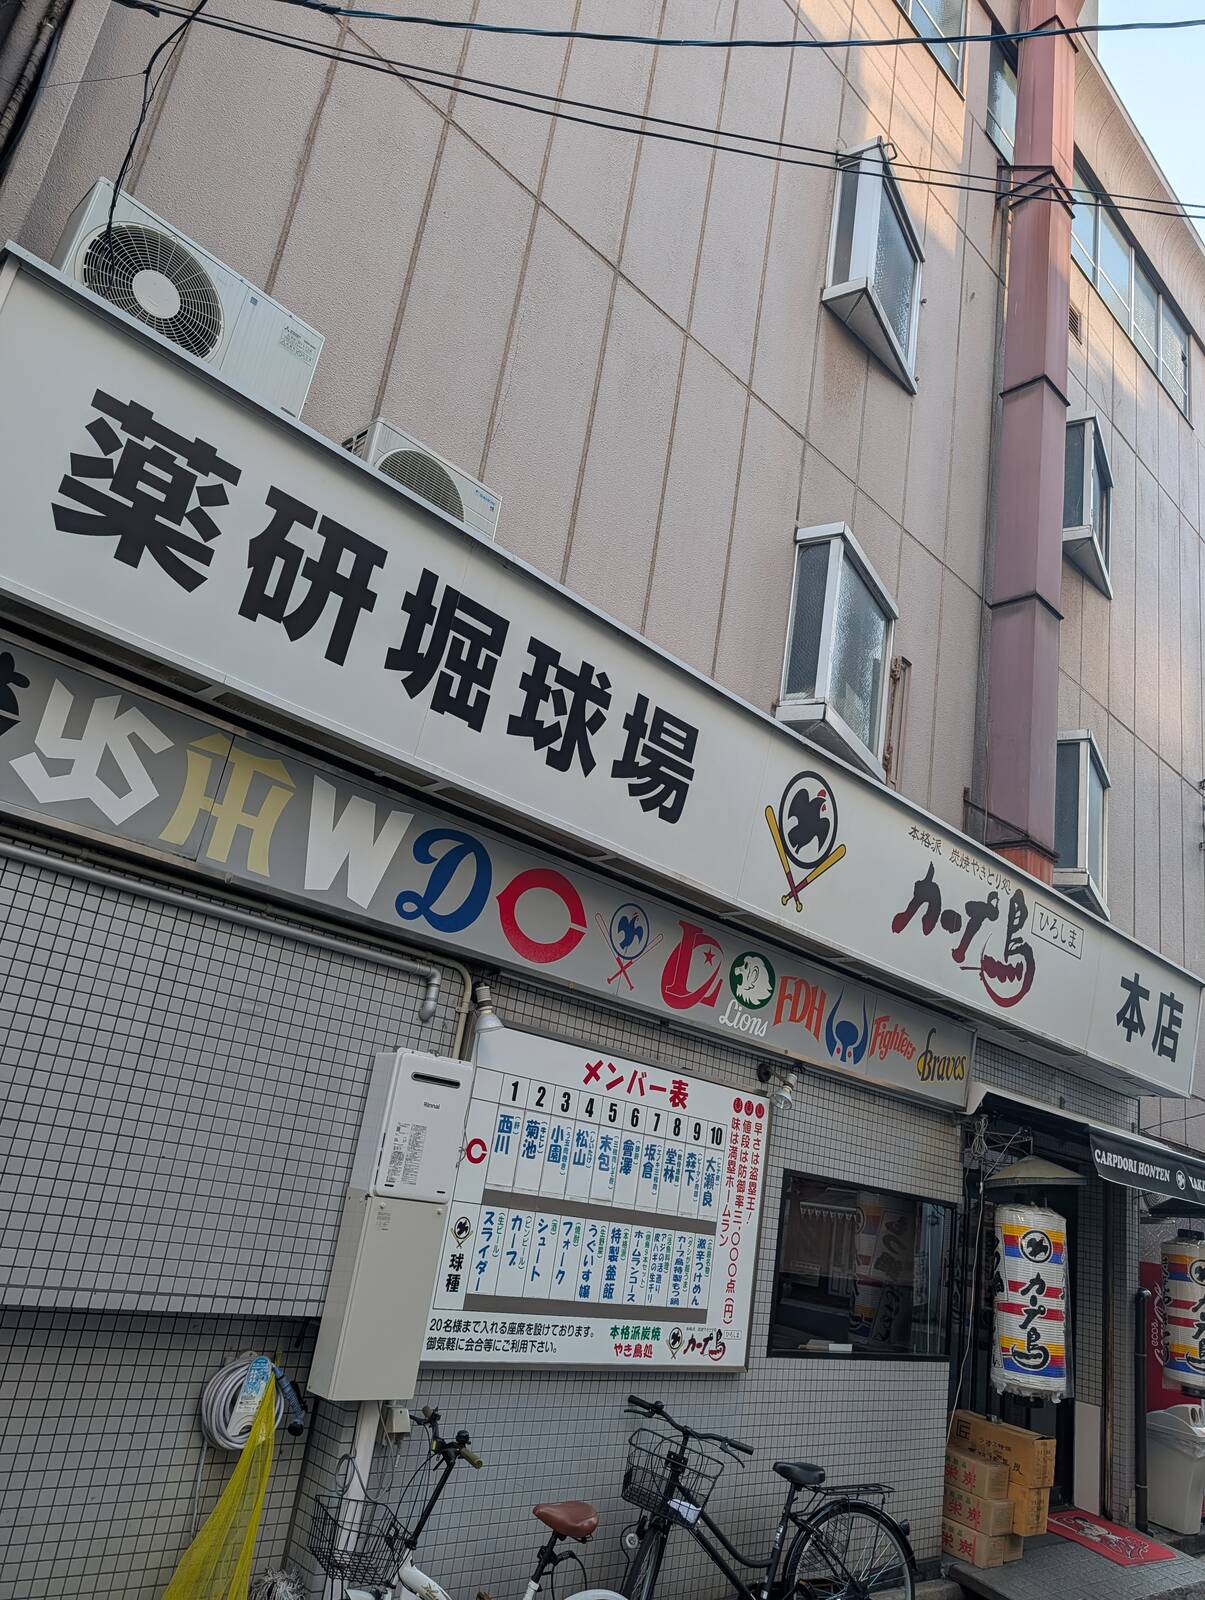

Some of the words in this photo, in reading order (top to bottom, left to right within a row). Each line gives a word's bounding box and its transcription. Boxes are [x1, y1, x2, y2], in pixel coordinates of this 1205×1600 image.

[51, 387, 699, 825] 薬研堀球場
[304, 775, 414, 909] W
[908, 825, 942, 856] 本格派
[396, 828, 492, 933] D
[1038, 911, 1077, 950] ひろしま
[718, 1000, 768, 1038] Lions
[773, 975, 827, 1042] FDH
[1116, 972, 1184, 1063] 本店
[869, 1015, 917, 1062] Fighters
[917, 1027, 967, 1082] Braves
[511, 1081, 519, 1101] 1
[535, 1086, 546, 1107] 2
[561, 1092, 571, 1112] 3
[583, 1060, 689, 1110] メンバー表
[585, 1098, 594, 1117] 4
[608, 1103, 617, 1122] 5
[631, 1108, 640, 1127] 6
[654, 1113, 661, 1132] 7
[494, 1114, 514, 1154] 西川
[522, 1120, 540, 1159] 菊池
[547, 1125, 564, 1163] 小園
[673, 1118, 682, 1136] 8
[693, 1122, 701, 1141] 9
[710, 1127, 723, 1145] 10
[573, 1129, 589, 1166] 松山
[598, 1134, 613, 1171] 末包
[642, 1144, 657, 1179] 坂倉
[663, 1148, 677, 1183] 堂林
[1094, 1149, 1137, 1174] CARPDORI
[1138, 1161, 1170, 1182] HONTEN
[685, 1152, 697, 1186] 森下
[702, 1157, 717, 1207] 大瀬良
[719, 1117, 741, 1247] 味は満塁ホームラン
[475, 1211, 495, 1291] スライダー
[531, 1218, 548, 1281] シュート
[555, 1221, 573, 1285] フォーク
[579, 1224, 597, 1298] うぐいす嬢
[603, 1227, 622, 1299] 特製釜飯
[627, 1230, 643, 1302] ホームランコース
[446, 1253, 464, 1293] 球種
[691, 1238, 706, 1306] 激辛つけめん
[426, 1337, 557, 1354] 御気軽に会合等にご利用下さい。
[429, 1318, 594, 1338] 20名様まで入れる座席を設けております。
[610, 1325, 661, 1341] 本格派炭焼
[613, 1343, 653, 1358] やき鳥処
